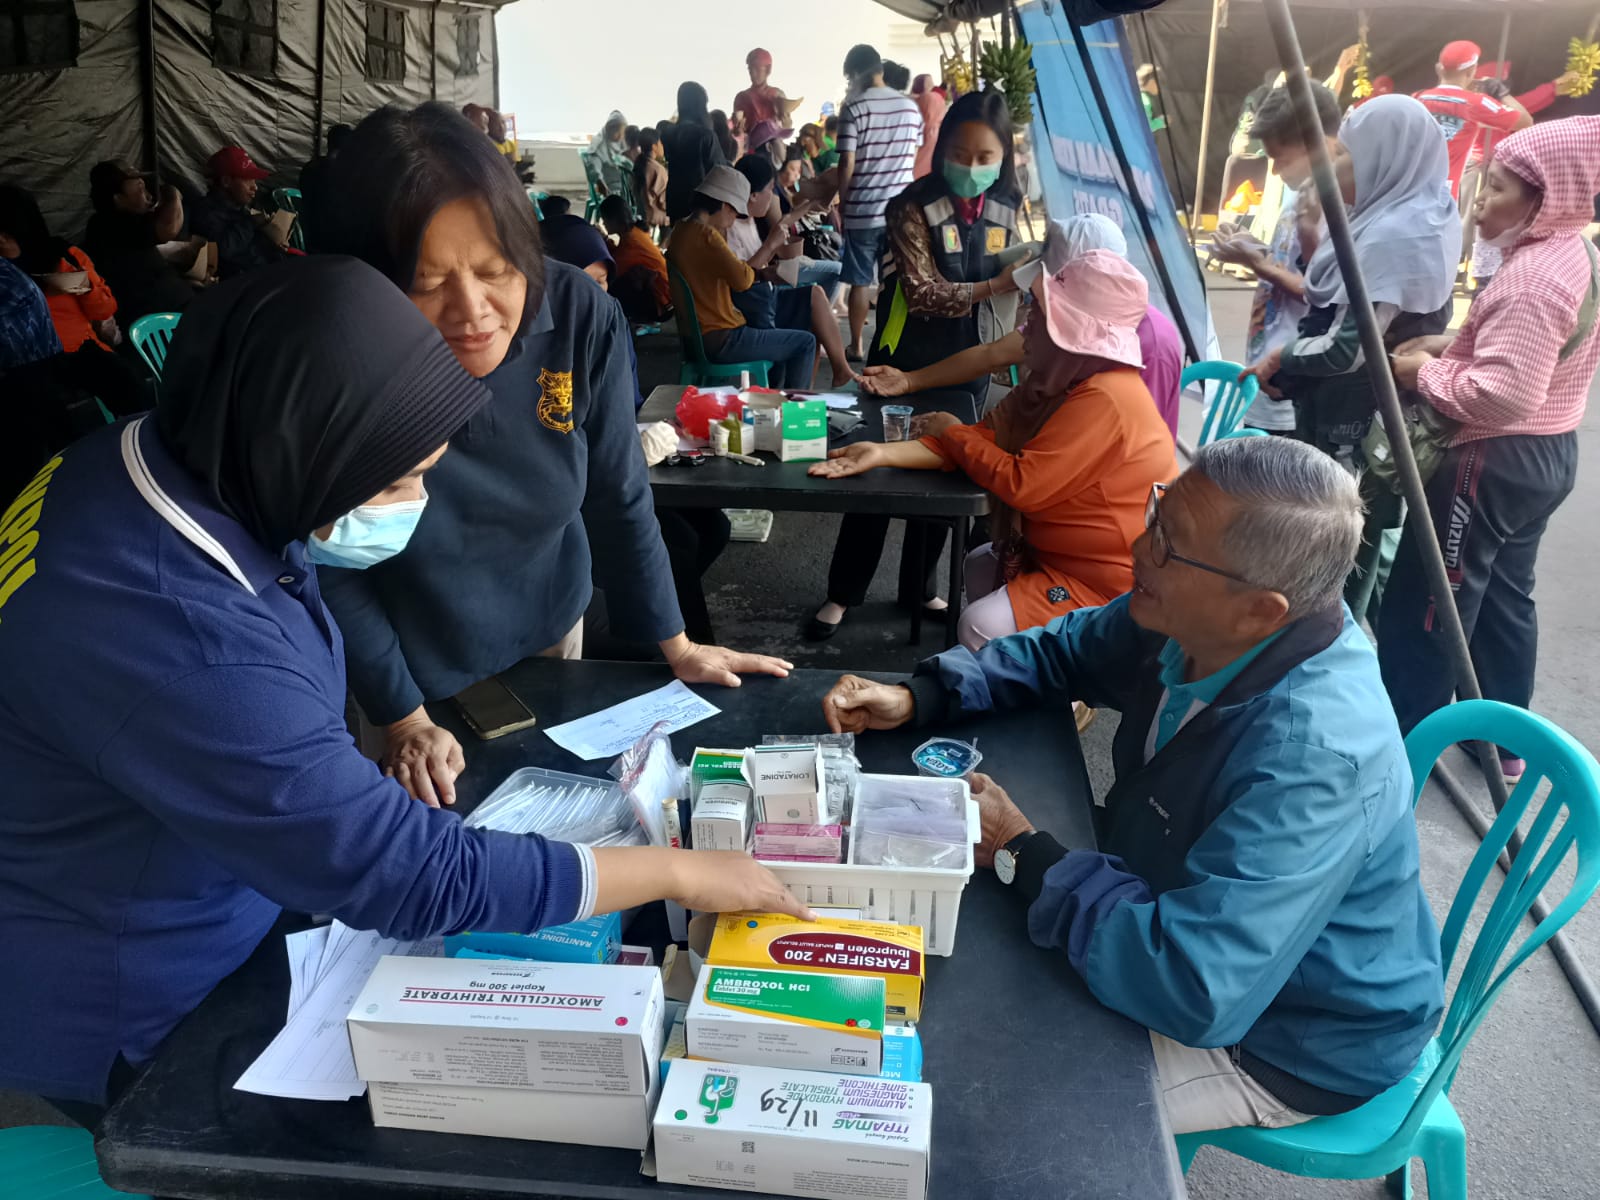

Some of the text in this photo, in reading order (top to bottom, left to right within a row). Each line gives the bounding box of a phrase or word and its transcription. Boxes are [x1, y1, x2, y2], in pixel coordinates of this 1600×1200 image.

[760, 772, 810, 781] LORATADINE
[540, 933, 592, 948] RANITIDINE
[784, 950, 813, 961] 200
[848, 944, 910, 958] Ibuprofen
[469, 980, 545, 992] Kaplet 500 mg
[714, 977, 785, 991] AMBROXOL
[403, 989, 603, 1007] AMOXICILLIN TRIHYDRATE
[779, 1081, 907, 1101] MAGNESIUM TRISILICATE
[837, 1078, 908, 1092] SIMETHICONE
[786, 1091, 908, 1110] ALUMINIUM HYDROXIDE
[832, 1118, 910, 1134] ITRAMAG
